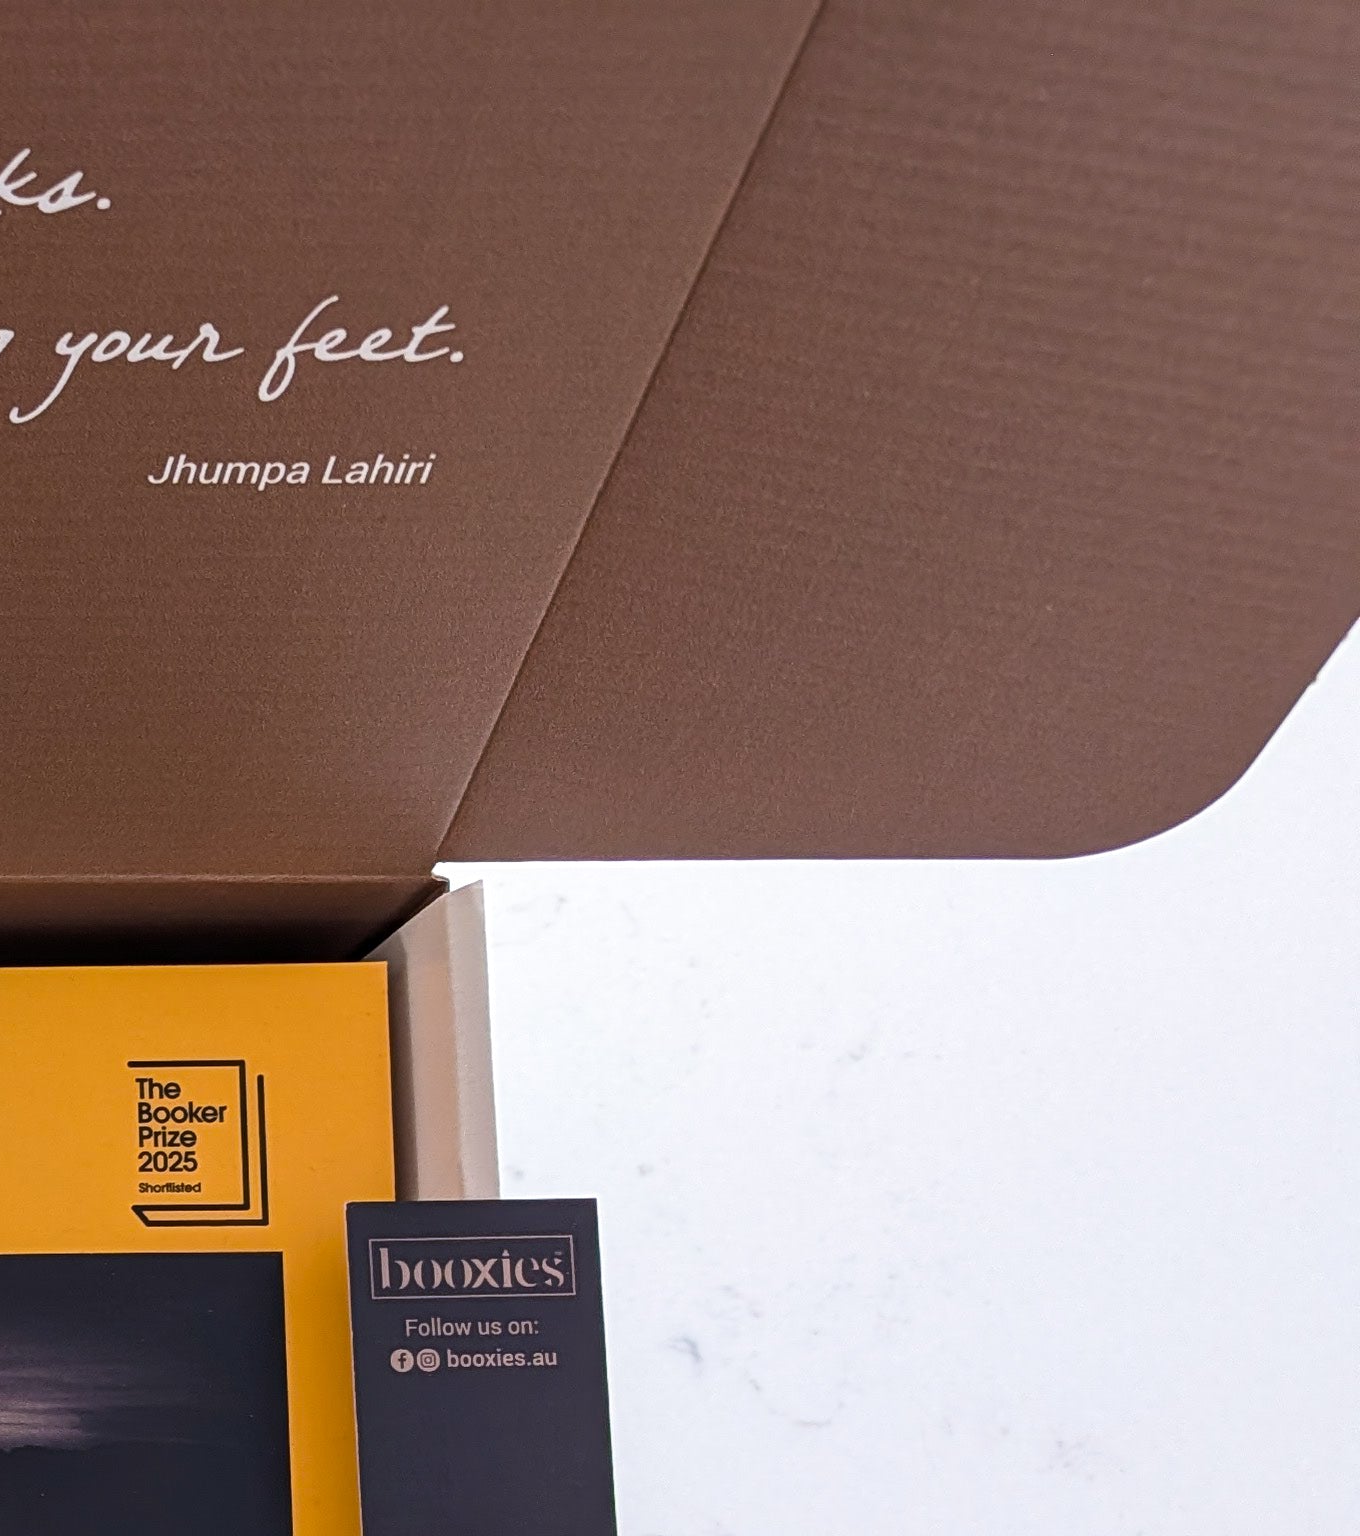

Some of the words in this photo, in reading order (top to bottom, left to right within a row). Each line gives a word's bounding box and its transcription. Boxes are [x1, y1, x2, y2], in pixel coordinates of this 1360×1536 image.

[9, 321, 243, 424] your
[256, 295, 465, 401] feet.
[148, 454, 310, 491] Jhumpa
[321, 454, 436, 484] Lahiri
[135, 1078, 181, 1099] The
[138, 1101, 227, 1123] Booker
[139, 1126, 197, 1147] Prize
[138, 1151, 198, 1172] 2025
[138, 1182, 201, 1193] Shortlisted
[380, 1248, 564, 1290] booxies
[406, 1317, 471, 1337] Follow
[478, 1322, 502, 1335] us
[508, 1320, 539, 1334] on:
[447, 1348, 557, 1367] booxies.au
